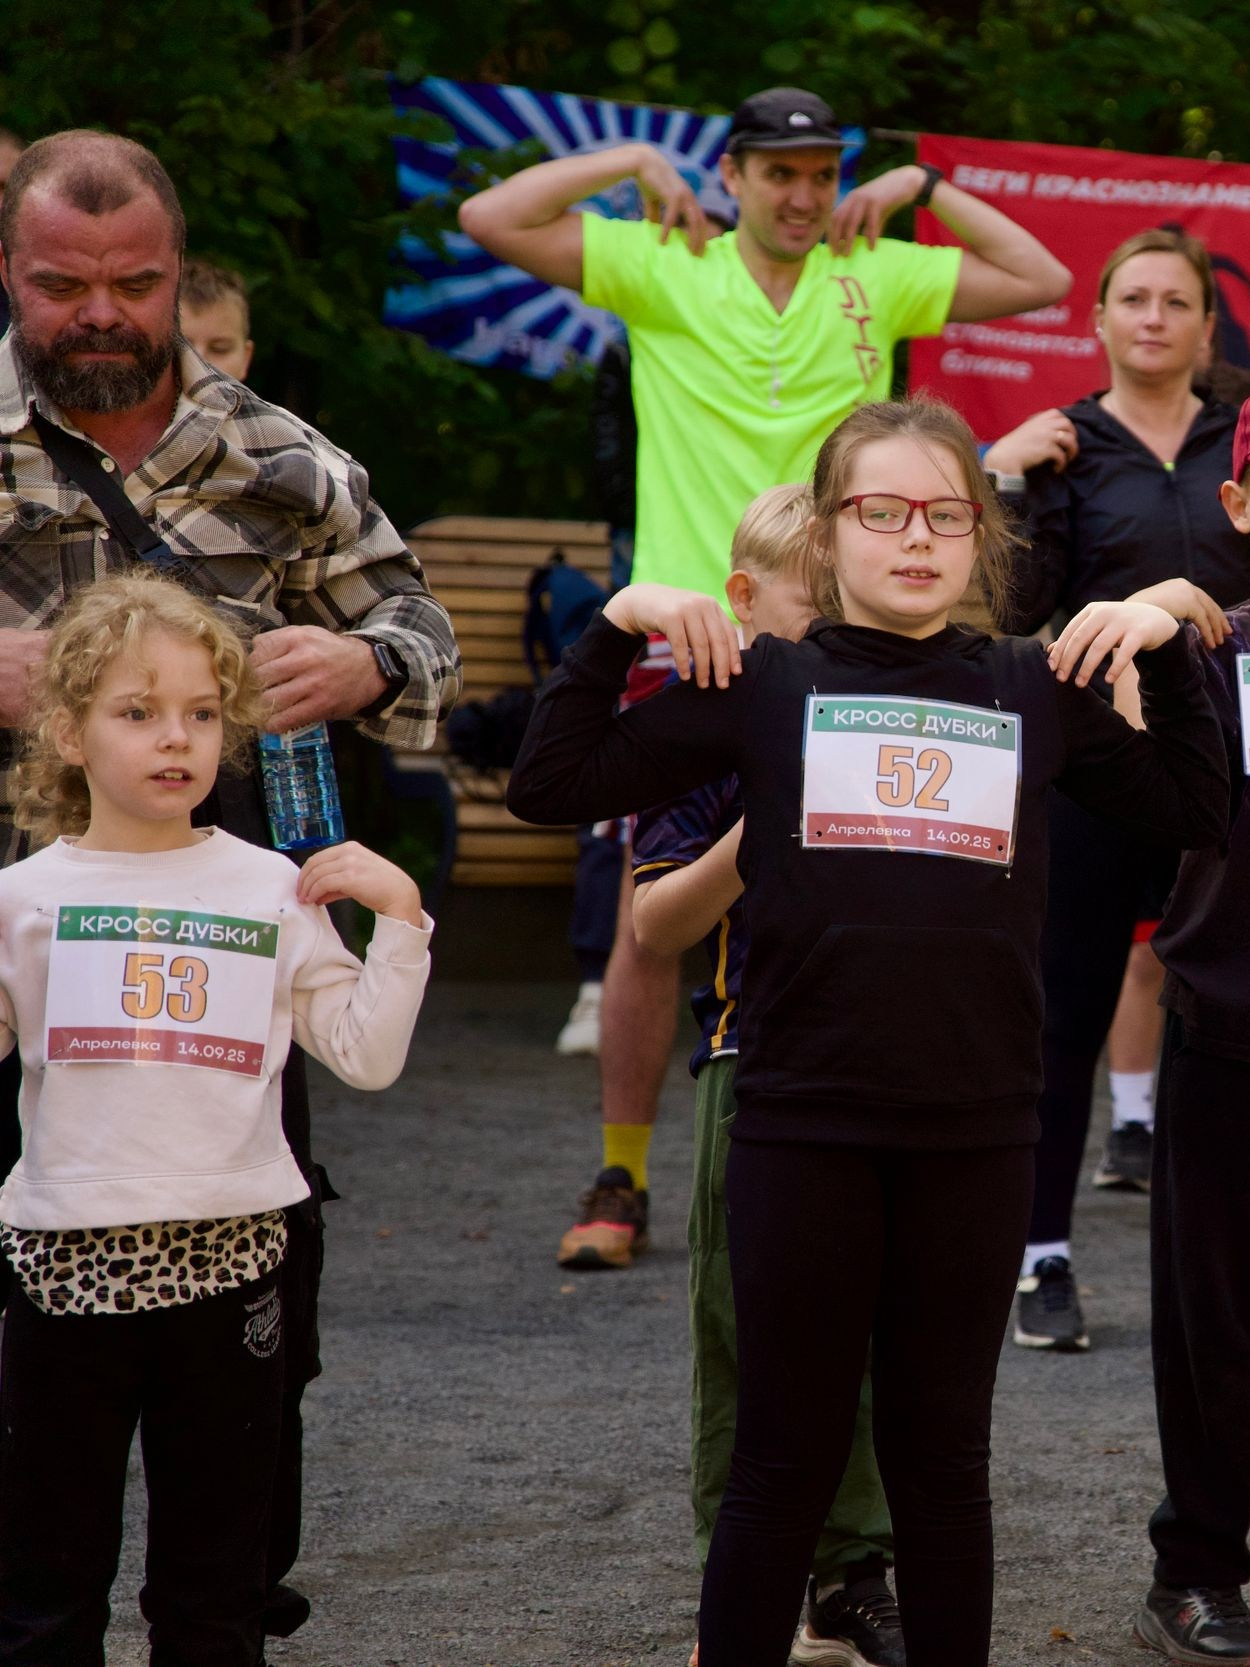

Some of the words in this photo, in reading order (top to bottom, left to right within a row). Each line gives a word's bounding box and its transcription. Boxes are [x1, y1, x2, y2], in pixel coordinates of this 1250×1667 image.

[952, 163, 1029, 195] БЕГИ
[833, 708, 918, 729] КРОСС
[921, 714, 997, 741] ДУБКИ
[875, 744, 953, 812] 52
[826, 823, 912, 839] Апрелевка
[926, 828, 992, 850] 14.09.25
[79, 915, 171, 936] КРОСС
[175, 920, 259, 948] ДУБКИ
[120, 952, 209, 1023] 53
[68, 1037, 161, 1053] Апрелевка
[177, 1040, 247, 1064] 14.09.25
